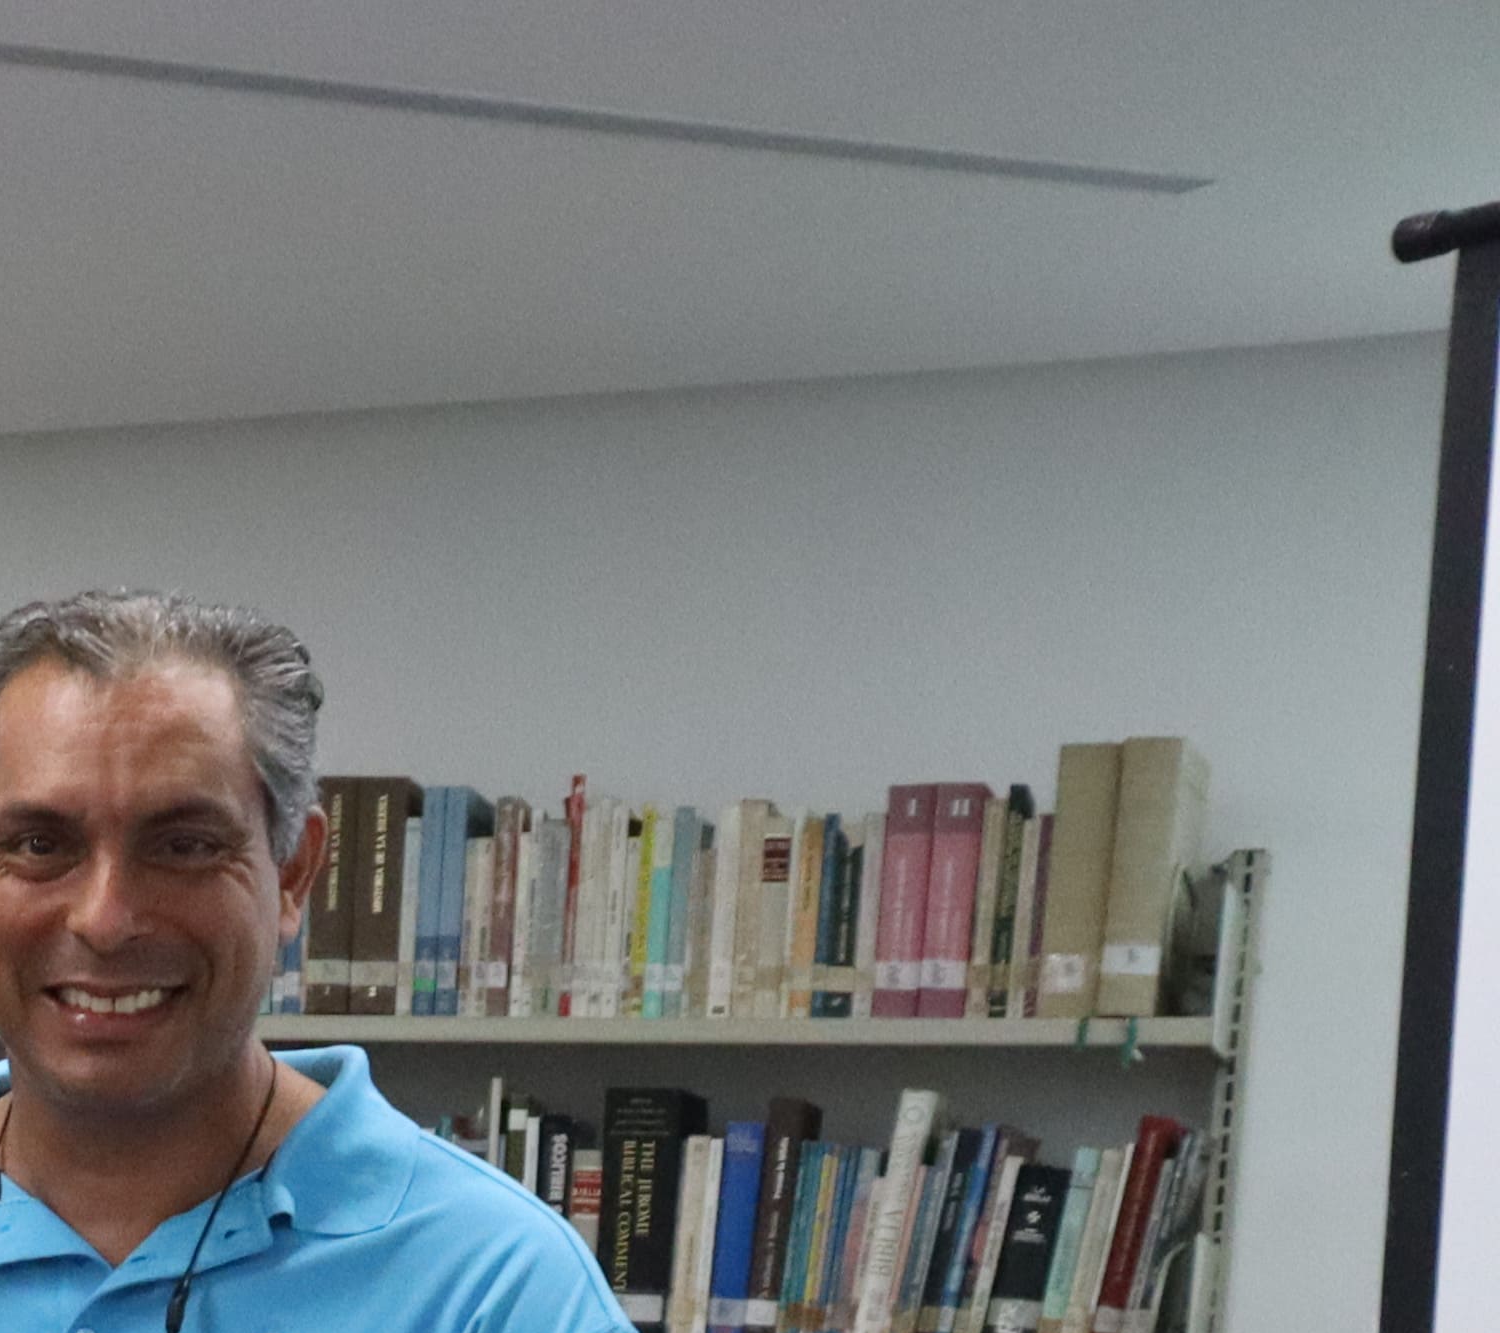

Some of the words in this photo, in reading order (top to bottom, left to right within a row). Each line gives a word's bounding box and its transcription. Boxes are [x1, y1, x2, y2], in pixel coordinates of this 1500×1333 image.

[619, 1140, 637, 1206] BIBLICAL
[641, 1140, 656, 1173] THE
[635, 1178, 654, 1237] JEROME
